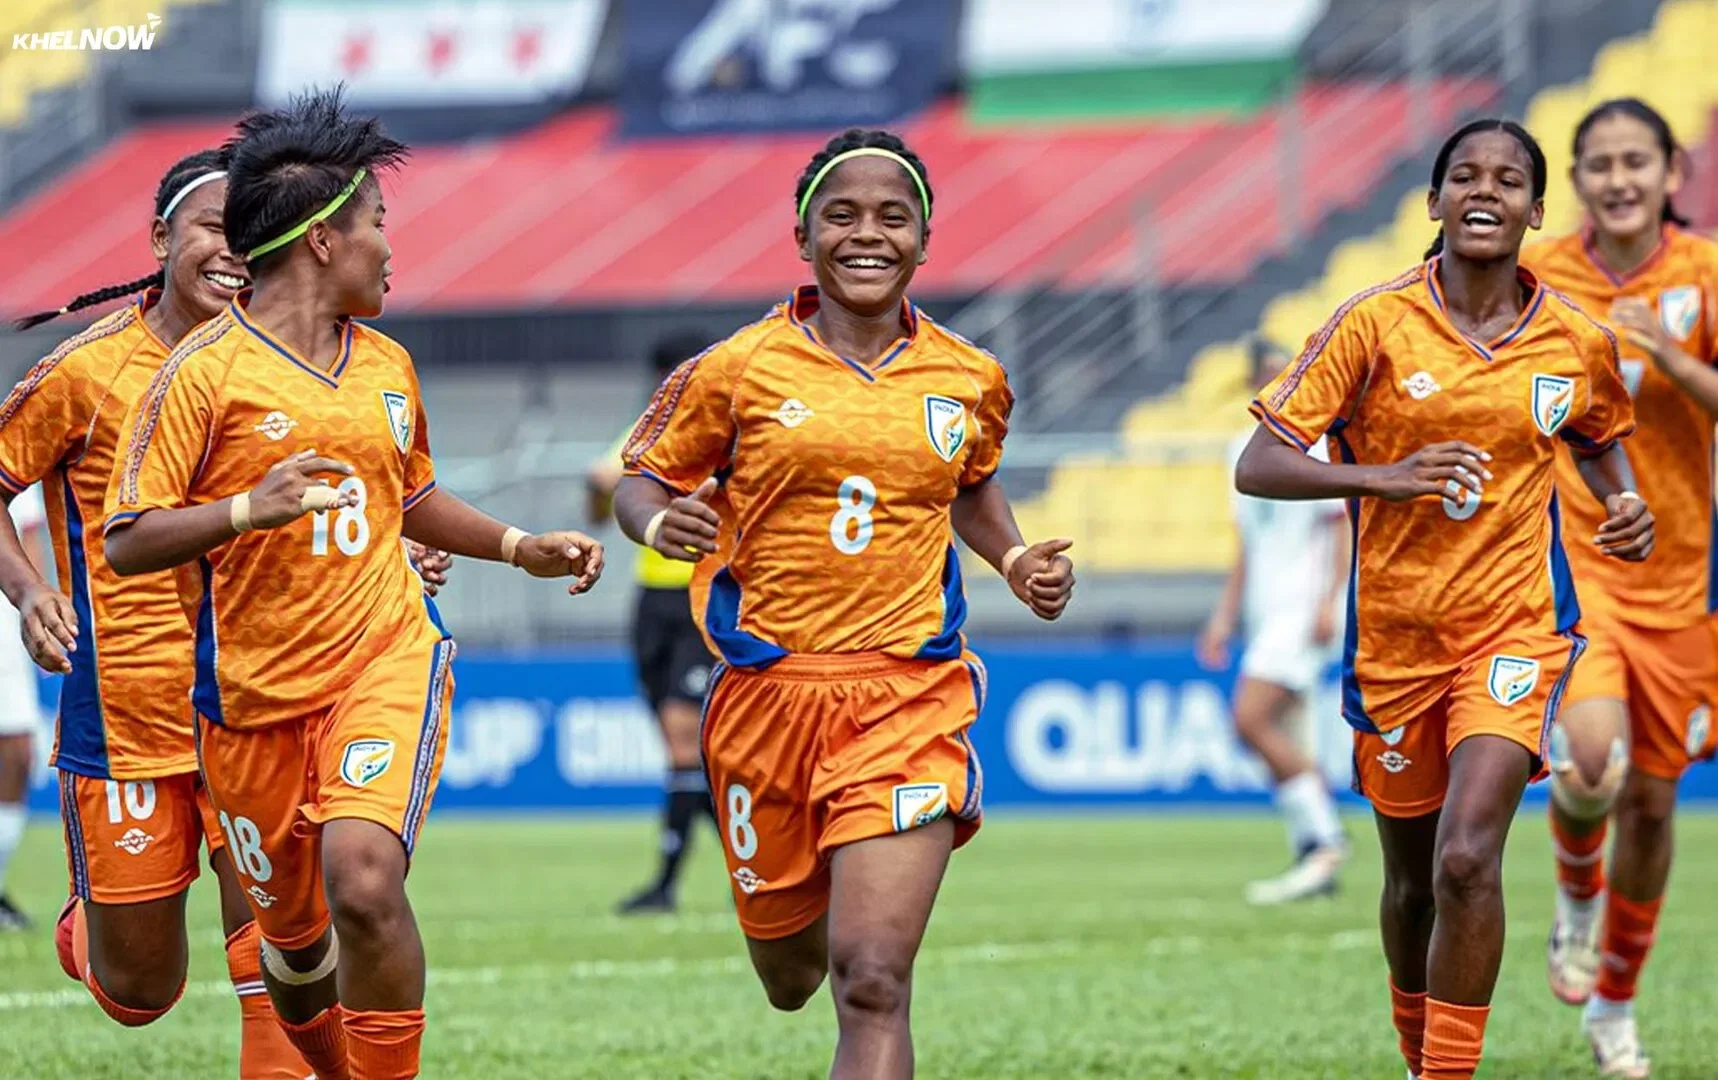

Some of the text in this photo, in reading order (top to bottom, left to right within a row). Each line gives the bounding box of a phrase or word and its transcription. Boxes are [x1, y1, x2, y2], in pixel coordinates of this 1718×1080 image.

[311, 475, 371, 557] 18
[829, 474, 878, 556] 8
[105, 779, 157, 824] 10
[728, 783, 758, 861] 8
[219, 810, 273, 882] 18
